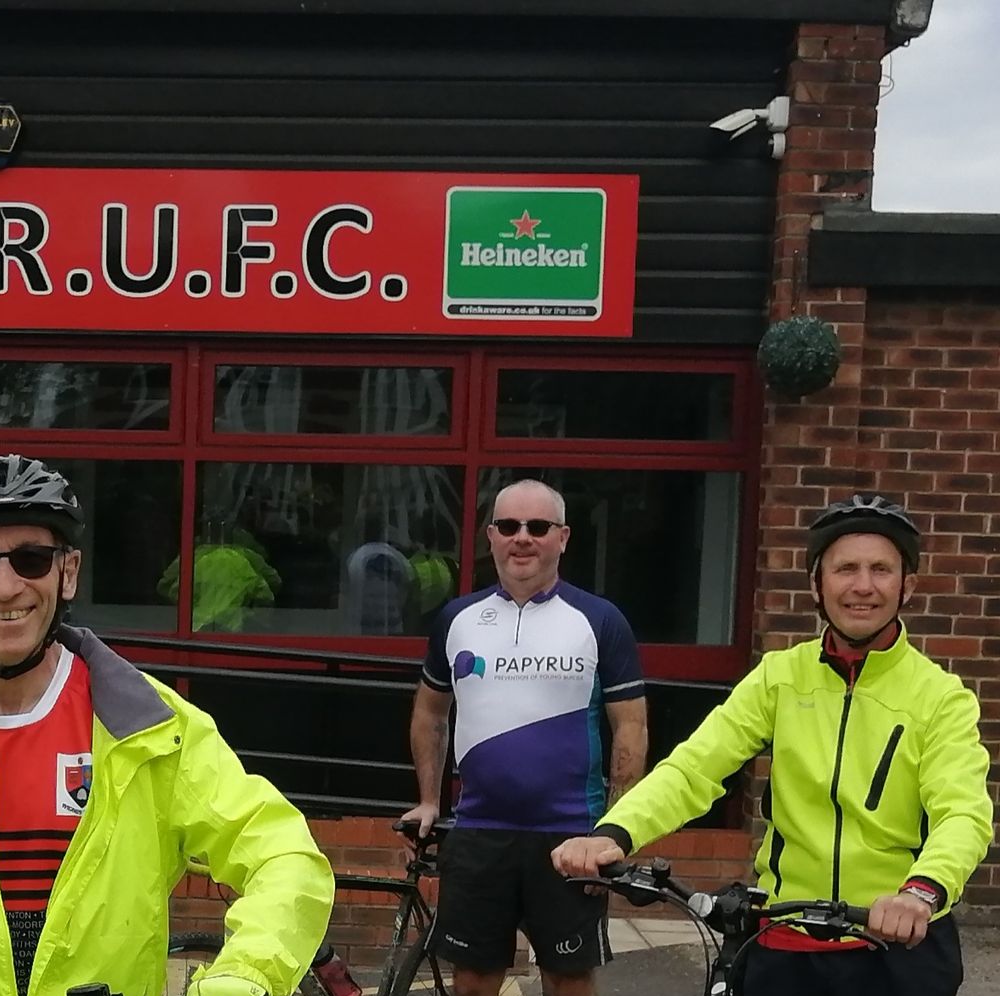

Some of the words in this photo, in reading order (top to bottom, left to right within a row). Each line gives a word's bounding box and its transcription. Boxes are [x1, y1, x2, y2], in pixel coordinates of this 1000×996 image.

[460, 242, 588, 268] Heineken
[459, 306, 540, 315] drinkaware.co.uk
[495, 656, 585, 673] PAPYRUS
[6, 911, 32, 919] NTON
